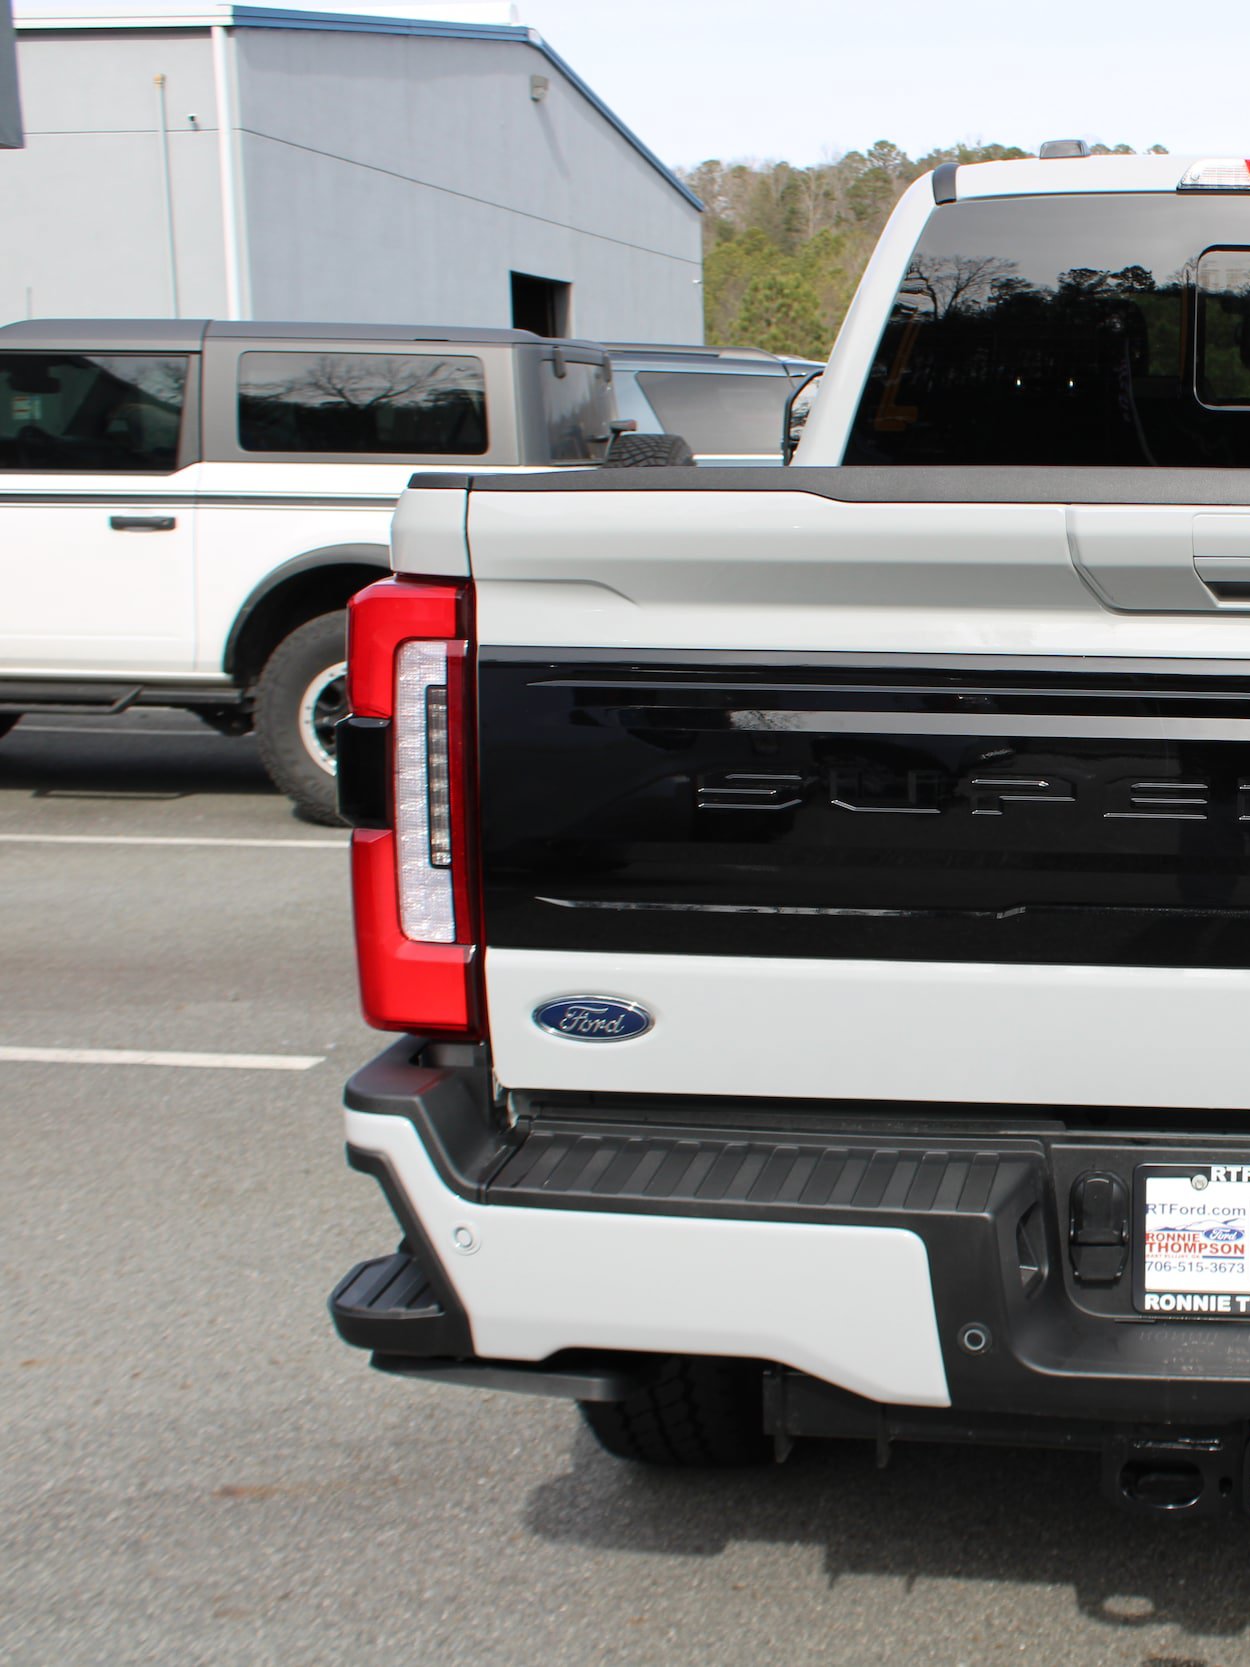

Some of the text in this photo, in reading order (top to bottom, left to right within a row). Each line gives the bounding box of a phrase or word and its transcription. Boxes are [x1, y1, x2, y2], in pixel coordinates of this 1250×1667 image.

[559, 1005, 625, 1033] Ford
[1145, 1203, 1246, 1216] RTFord.com
[1145, 1232, 1200, 1243] RONNIE
[1145, 1242, 1245, 1255] THOMPSON
[1145, 1261, 1245, 1274] 706-515-3673
[1144, 1294, 1231, 1313] RONNIE
